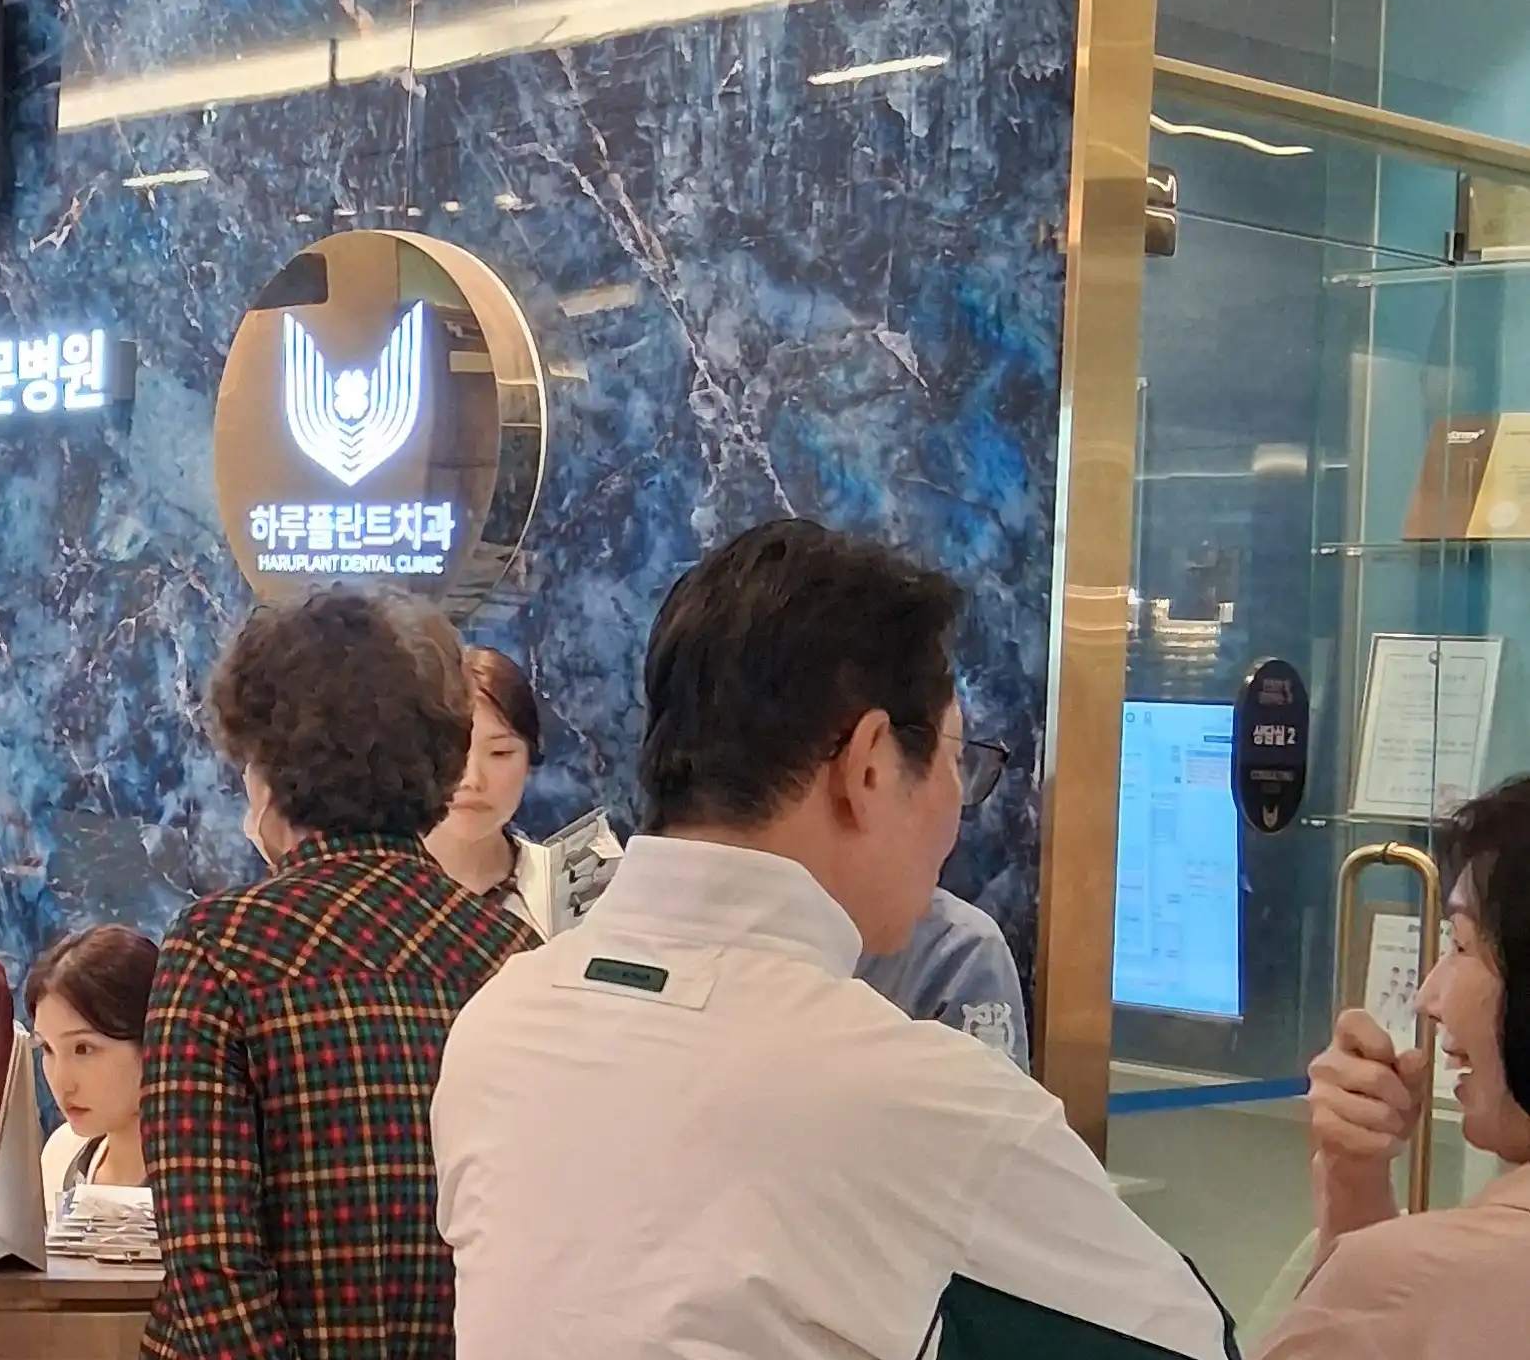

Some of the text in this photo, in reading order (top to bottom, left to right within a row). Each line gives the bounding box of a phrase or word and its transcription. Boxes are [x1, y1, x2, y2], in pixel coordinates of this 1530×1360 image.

[248, 500, 456, 552] 하루플란트치과
[257, 554, 446, 575] HARUPLANT DENTAL CLINIC
[1253, 724, 1296, 746] 상담실 2
